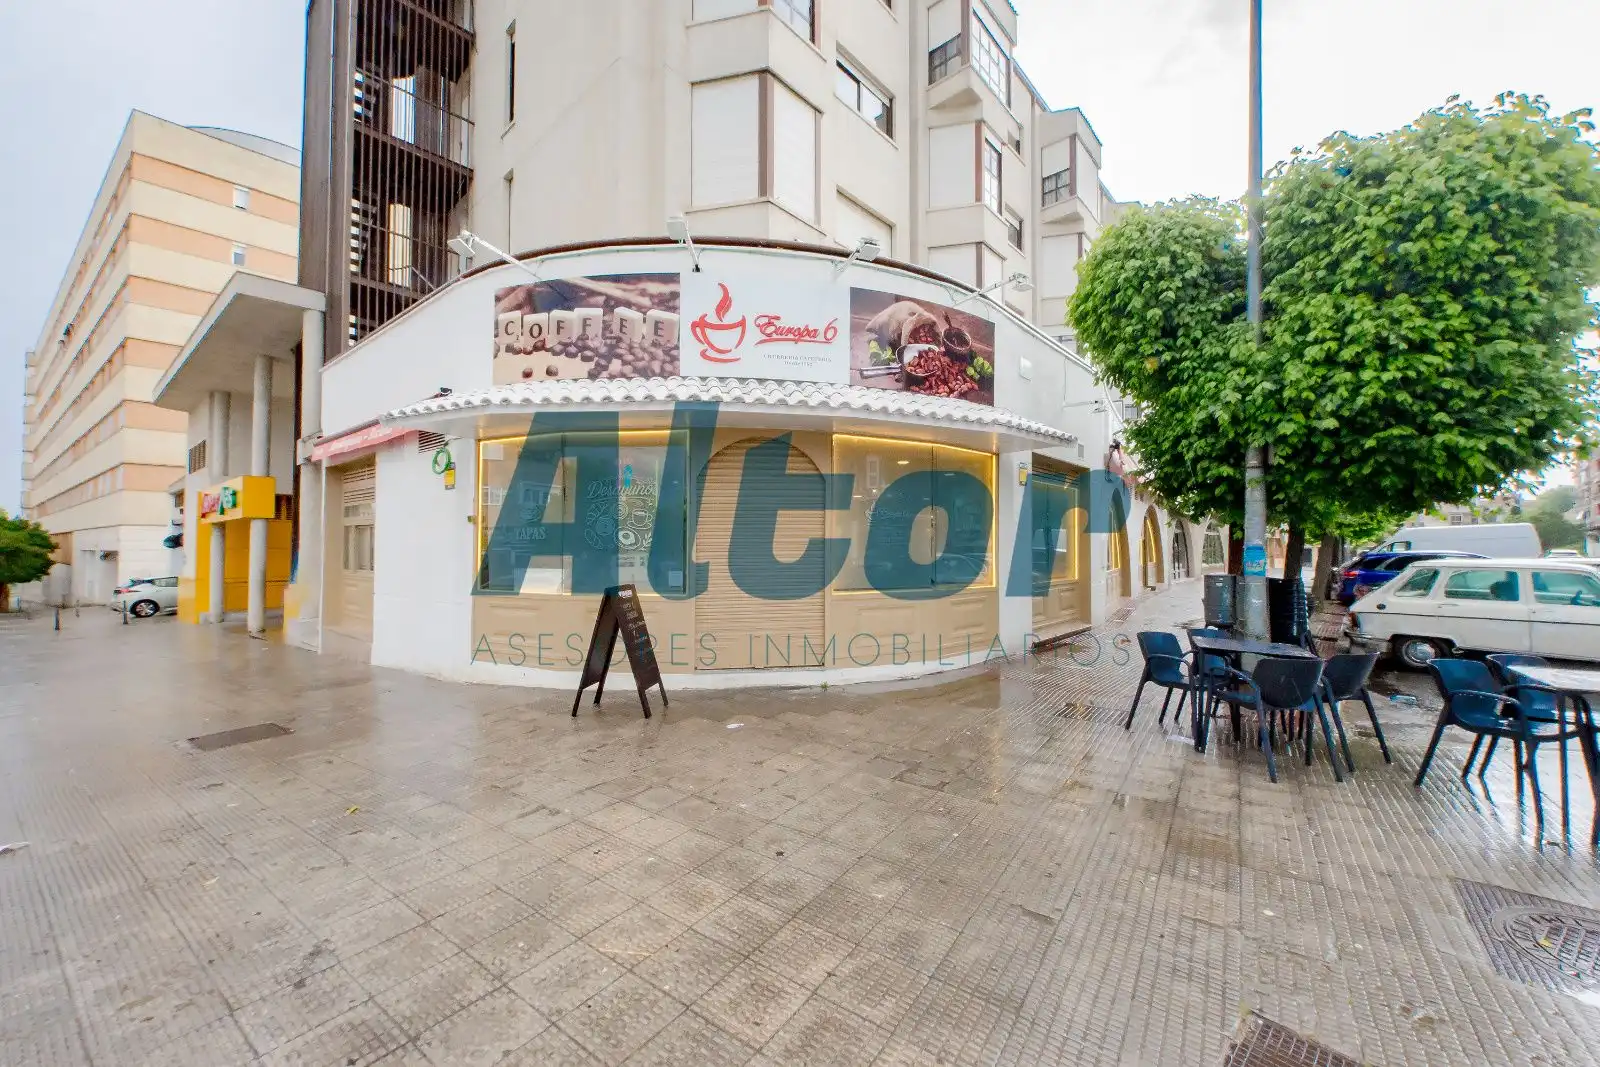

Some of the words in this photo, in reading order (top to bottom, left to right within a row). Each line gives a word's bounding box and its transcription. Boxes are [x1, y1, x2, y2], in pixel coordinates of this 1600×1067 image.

[504, 317, 664, 340] COFFEE
[754, 314, 820, 344] Europa
[823, 318, 838, 341] 6
[514, 527, 546, 540] TAPAS
